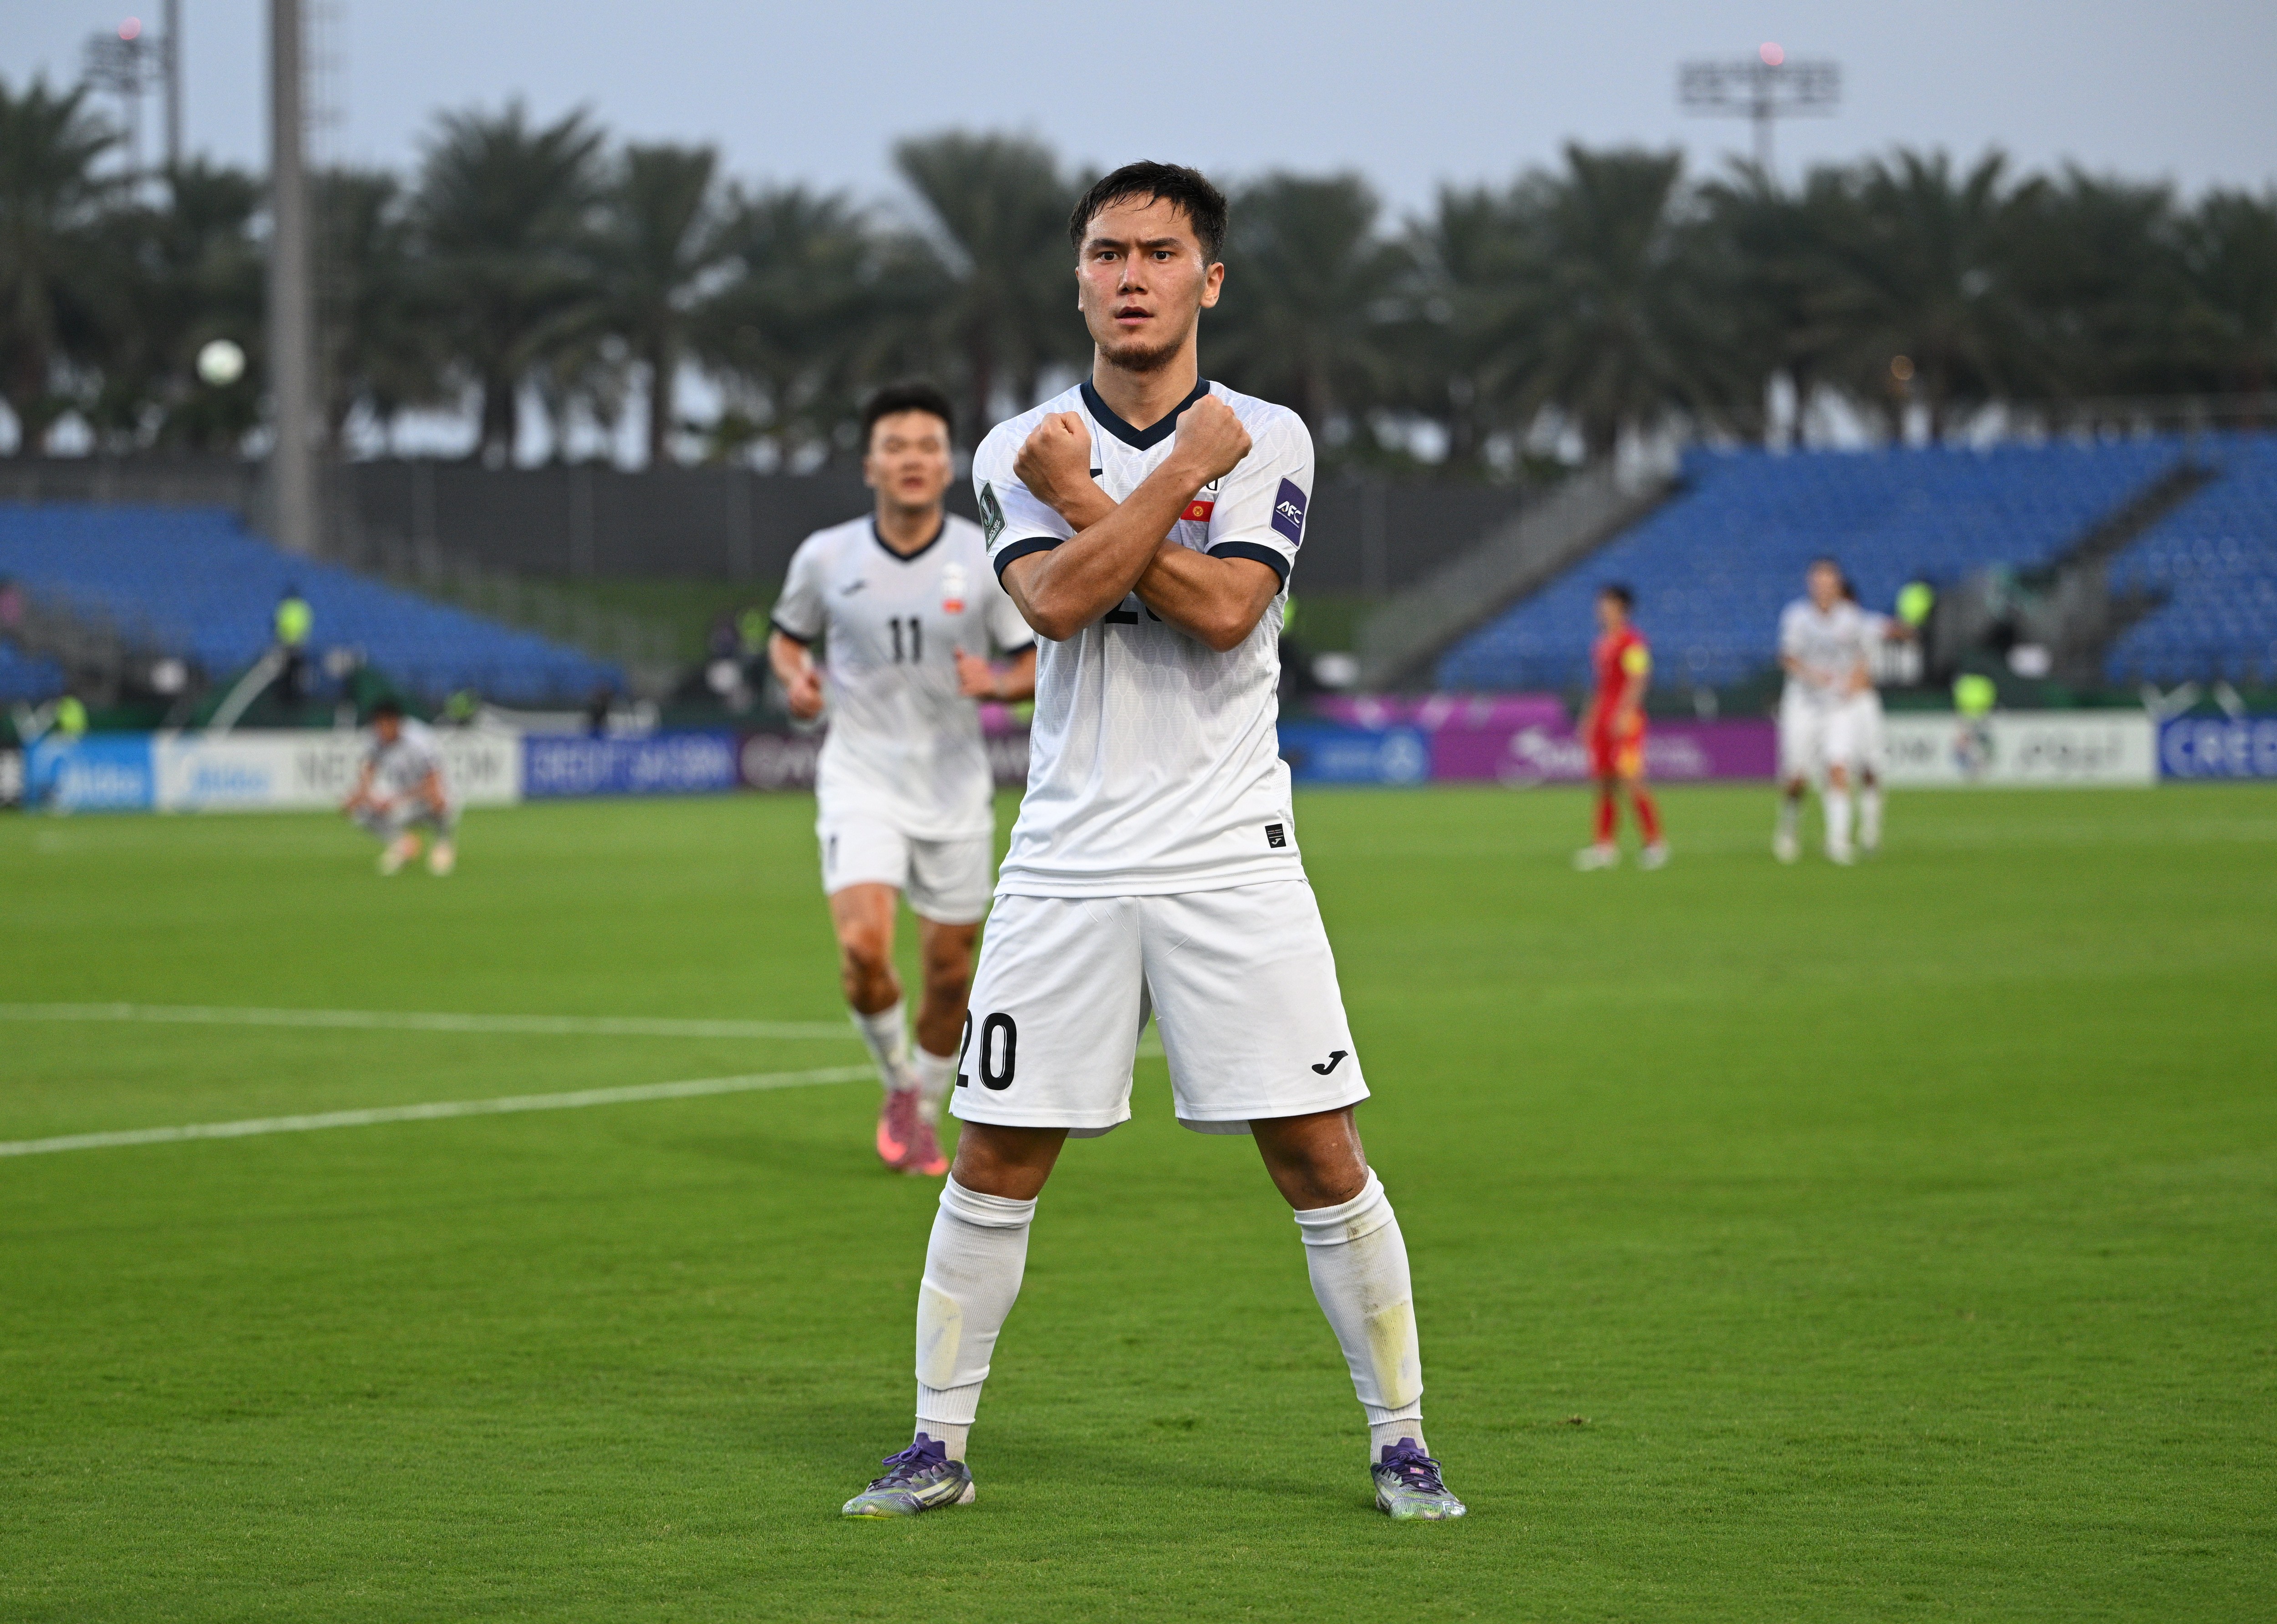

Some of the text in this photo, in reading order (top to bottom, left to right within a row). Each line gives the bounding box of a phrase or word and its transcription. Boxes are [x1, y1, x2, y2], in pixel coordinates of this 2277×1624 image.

[1276, 501, 1303, 524] AFC
[889, 618, 923, 664] 11
[956, 1009, 1017, 1091] 20
